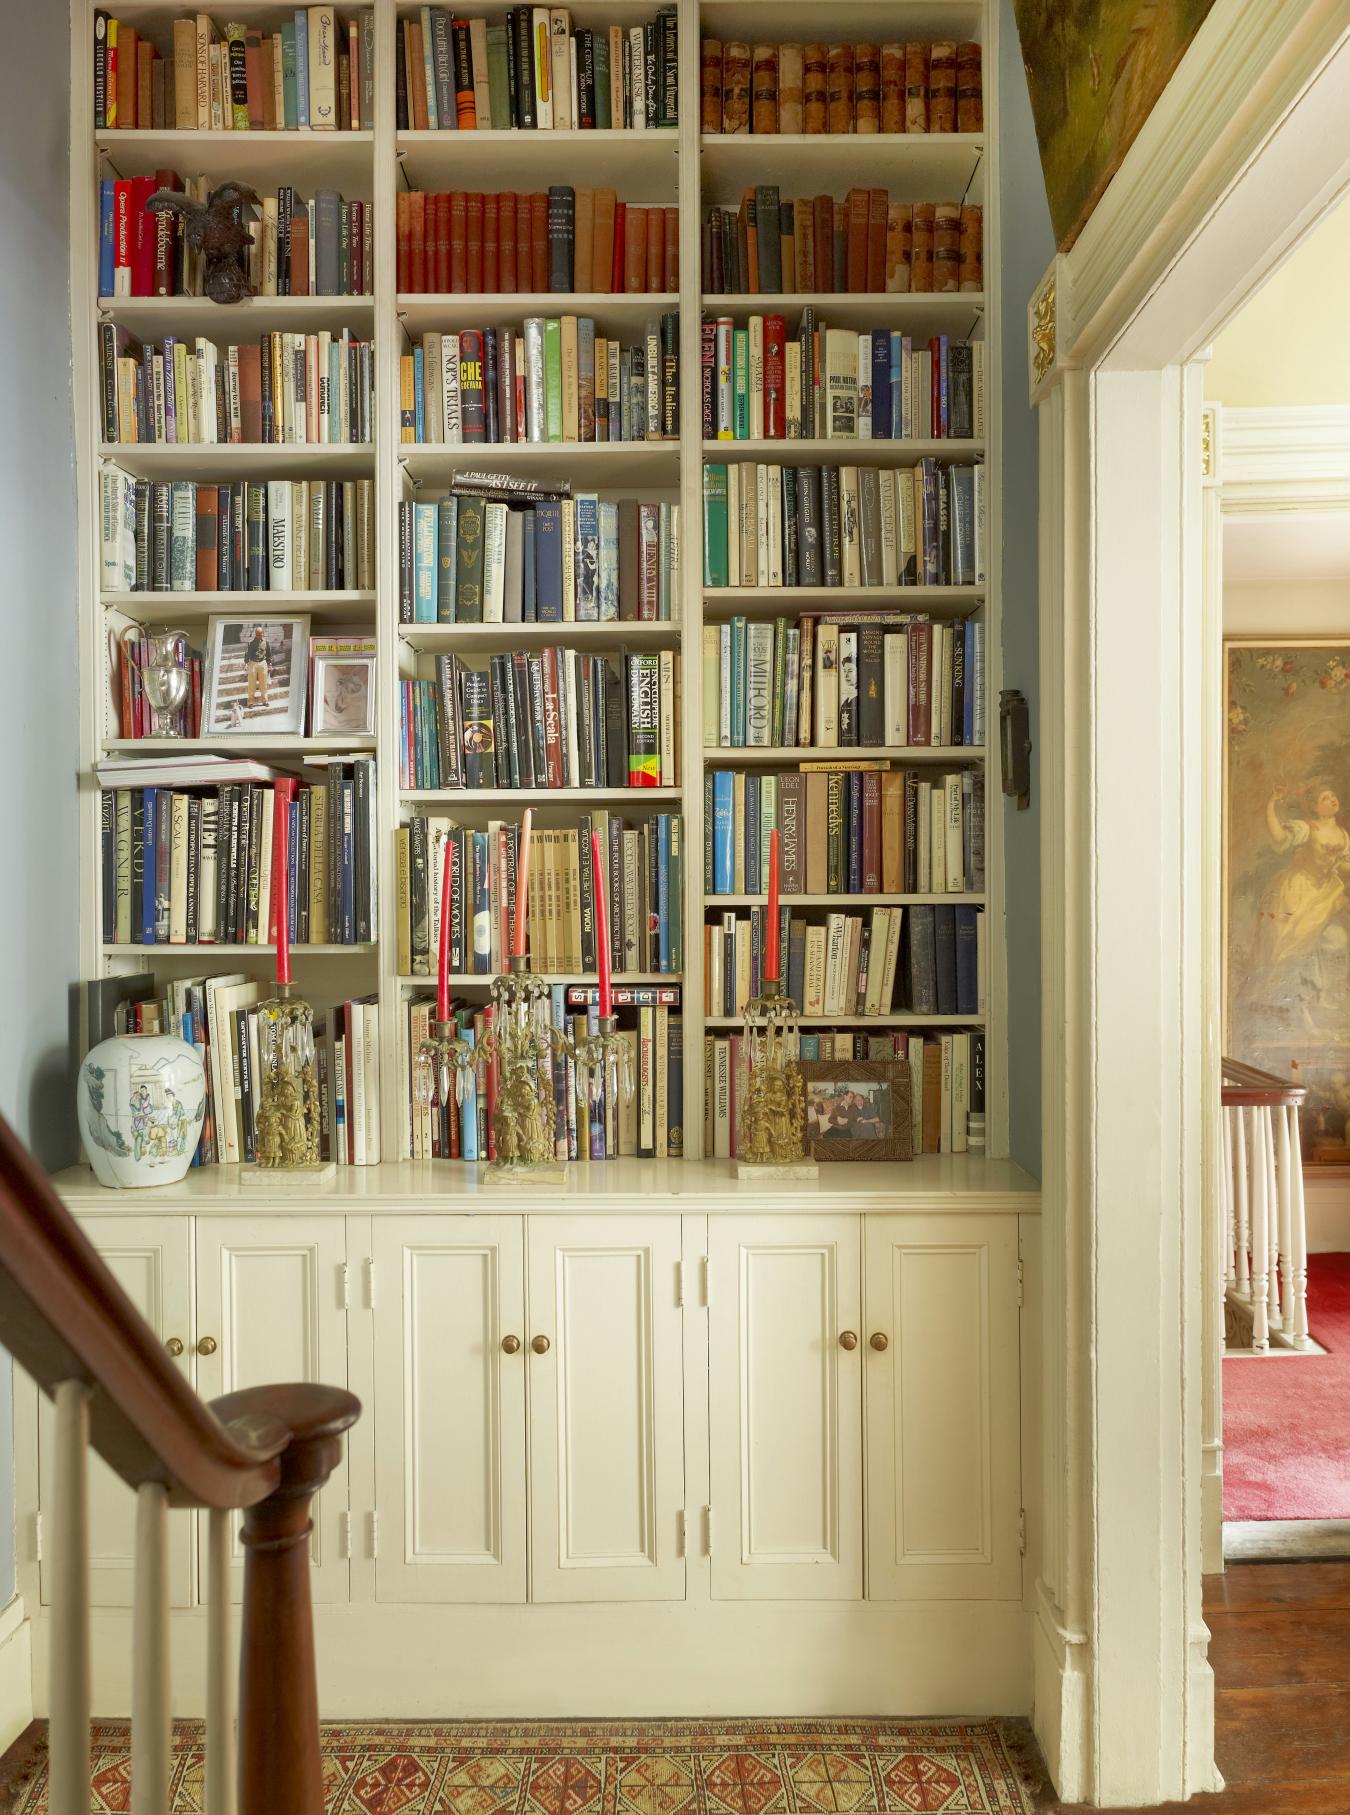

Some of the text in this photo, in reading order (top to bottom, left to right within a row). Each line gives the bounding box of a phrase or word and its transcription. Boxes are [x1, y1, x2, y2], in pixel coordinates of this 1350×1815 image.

[436, 18, 447, 35] Poor
[666, 17, 677, 27] The
[437, 37, 447, 54] Little
[665, 31, 677, 51] Letters
[198, 33, 208, 108] SONS OF HARVARD
[584, 33, 593, 85] THE CENTAUR
[633, 32, 643, 102] WINTER MUSIC
[645, 65, 655, 84] Only
[666, 70, 677, 85] Scott
[646, 86, 656, 118] Daughter
[665, 87, 678, 119] Fitzgerald
[119, 192, 128, 214] Opera
[119, 215, 128, 255] Production
[164, 340, 173, 361] Death
[231, 372, 239, 393] Journey
[461, 362, 482, 380] CHE
[609, 346, 618, 398] THE ARAB MIND
[647, 335, 659, 415] UNBUILT AMERICA
[703, 368, 712, 401] NICHOLAS
[166, 372, 175, 408] Zanzibar
[320, 377, 330, 415] CORONER
[445, 354, 460, 430] NOP'S TRIALS
[665, 357, 677, 431] The Italians
[704, 402, 712, 422] GAGE
[111, 485, 119, 501] Dark
[470, 472, 488, 480] PAUL
[489, 481, 503, 489] AS
[508, 482, 527, 490] SEE
[527, 483, 538, 491] IT
[803, 479, 811, 495] JOHN
[111, 502, 119, 514] Side
[157, 487, 168, 517] HERSELF
[883, 478, 893, 513] VIVIEN
[831, 472, 840, 560] MAPPLETHORPE
[273, 518, 285, 569] MAESTRO
[646, 541, 657, 601] HENRY VIII
[530, 662, 541, 689] QUILTS
[919, 646, 927, 682] WINDSOR
[954, 647, 963, 687] SUN KING
[631, 669, 639, 729] DICTIONARY
[639, 669, 651, 729] ENGLISH
[651, 669, 659, 729] ENCYCLOPEDIC
[749, 659, 769, 730] MITFORD
[919, 682, 927, 705] STORY
[533, 698, 542, 727] AMERICA
[545, 694, 559, 744] La Scala
[450, 735, 458, 770] RICHARDSON
[102, 794, 112, 833] Mozart
[240, 796, 250, 847] Opera People
[828, 776, 842, 836] Kennedys
[173, 798, 184, 851] LA SCALA
[784, 797, 798, 871] HENRY JAMES
[117, 805, 129, 898] WAGNER
[133, 808, 144, 884] VERDI
[313, 796, 324, 905] STORIA DELLA CASA
[507, 841, 515, 880] PORTRAIT
[612, 853, 620, 870] FOUR
[400, 867, 407, 875] e
[451, 848, 459, 885] WORLD
[612, 870, 620, 892] BOOKS
[400, 876, 409, 909] bisanzio
[434, 895, 441, 903] of
[452, 888, 460, 901] OF
[508, 882, 516, 893] OF
[508, 896, 516, 913] THE
[613, 892, 620, 902] OF
[625, 871, 635, 913] WAVERLEY
[452, 902, 460, 939] MOVIES
[584, 908, 592, 932] ROMA
[613, 903, 621, 950] ARCHITECTURE
[626, 914, 635, 938] ROOT
[830, 927, 843, 960] Wharton
[641, 1038, 652, 1087] ARCHAEOLOGISTS
[719, 1047, 727, 1118] TENNESSEE WILLIAMS
[321, 1085, 331, 1135] universal
